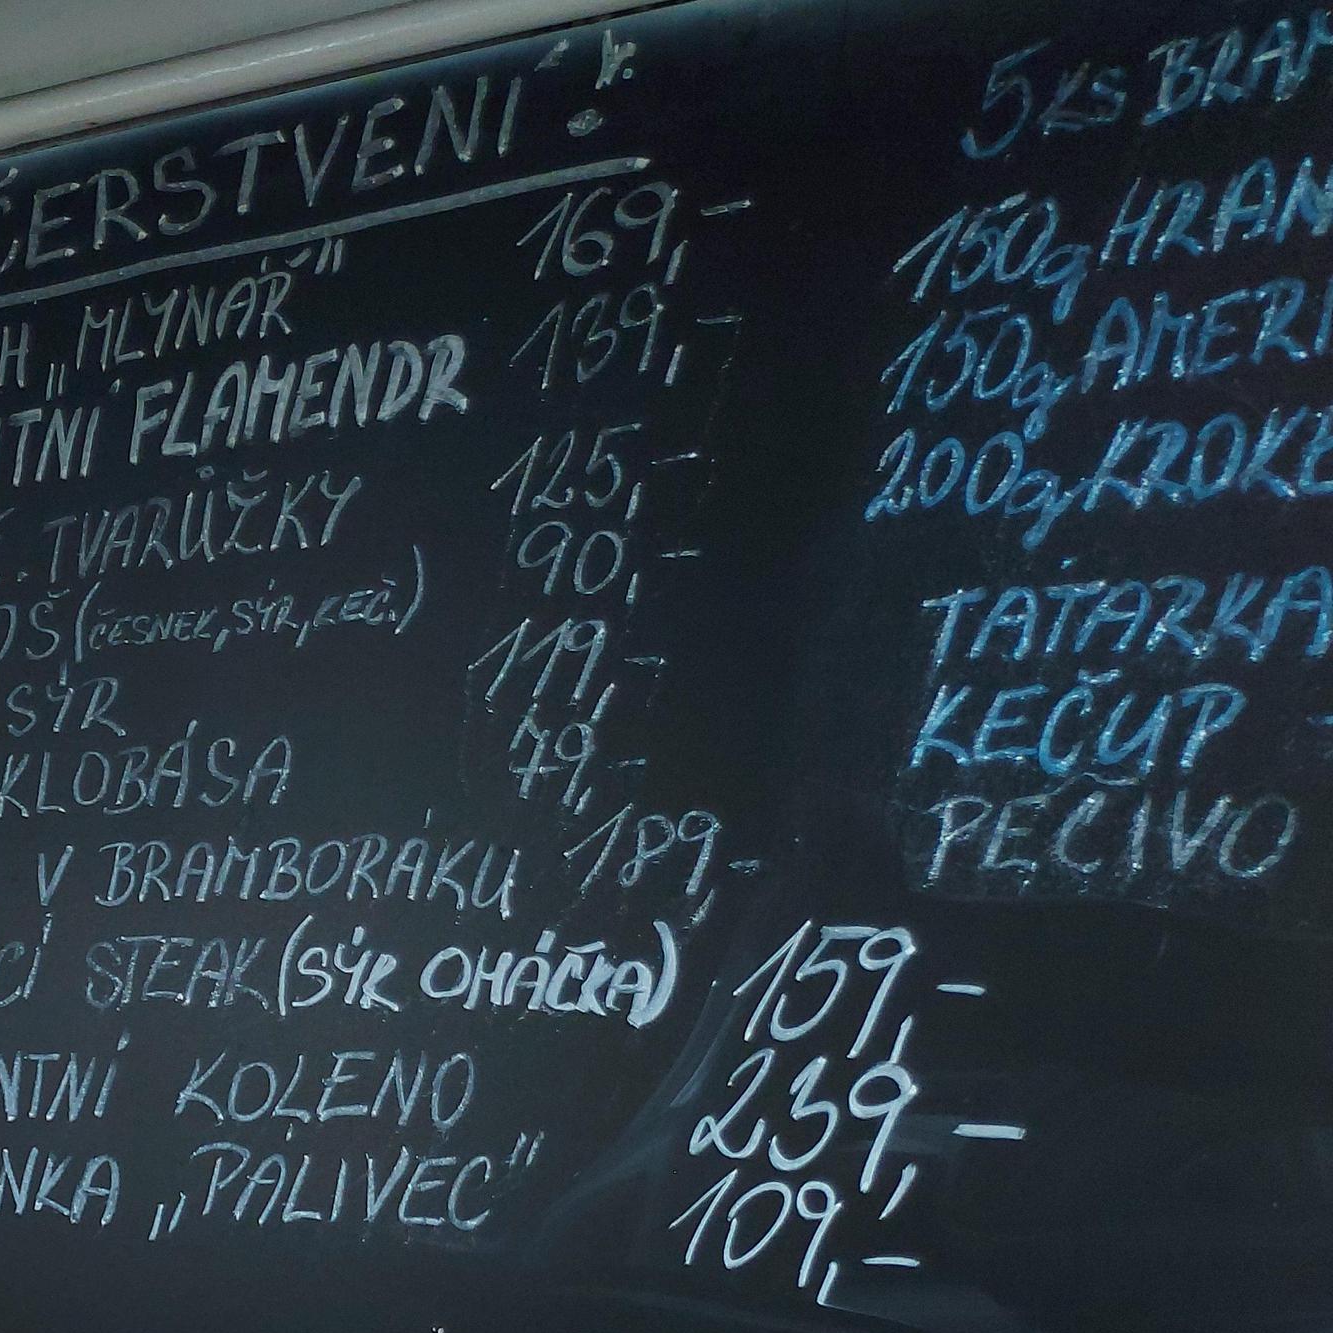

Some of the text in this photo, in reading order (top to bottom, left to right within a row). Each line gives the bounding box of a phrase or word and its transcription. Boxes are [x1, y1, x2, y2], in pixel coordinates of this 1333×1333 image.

[960, 38, 1052, 160] 5
[892, 190, 1092, 325] 150g
[129, 334, 468, 464] FLAMENDR
[880, 304, 1073, 441] 150g
[44, 464, 362, 583] TVARŮŽKY
[864, 428, 1081, 550] 200g
[6, 661, 127, 737] SÝR
[909, 667, 1249, 775] KEČUP
[37, 845, 75, 907] V
[94, 808, 520, 920] BRAMBORÁKU
[86, 934, 269, 1011] STEAK
[174, 1048, 476, 1130] KOLENO
